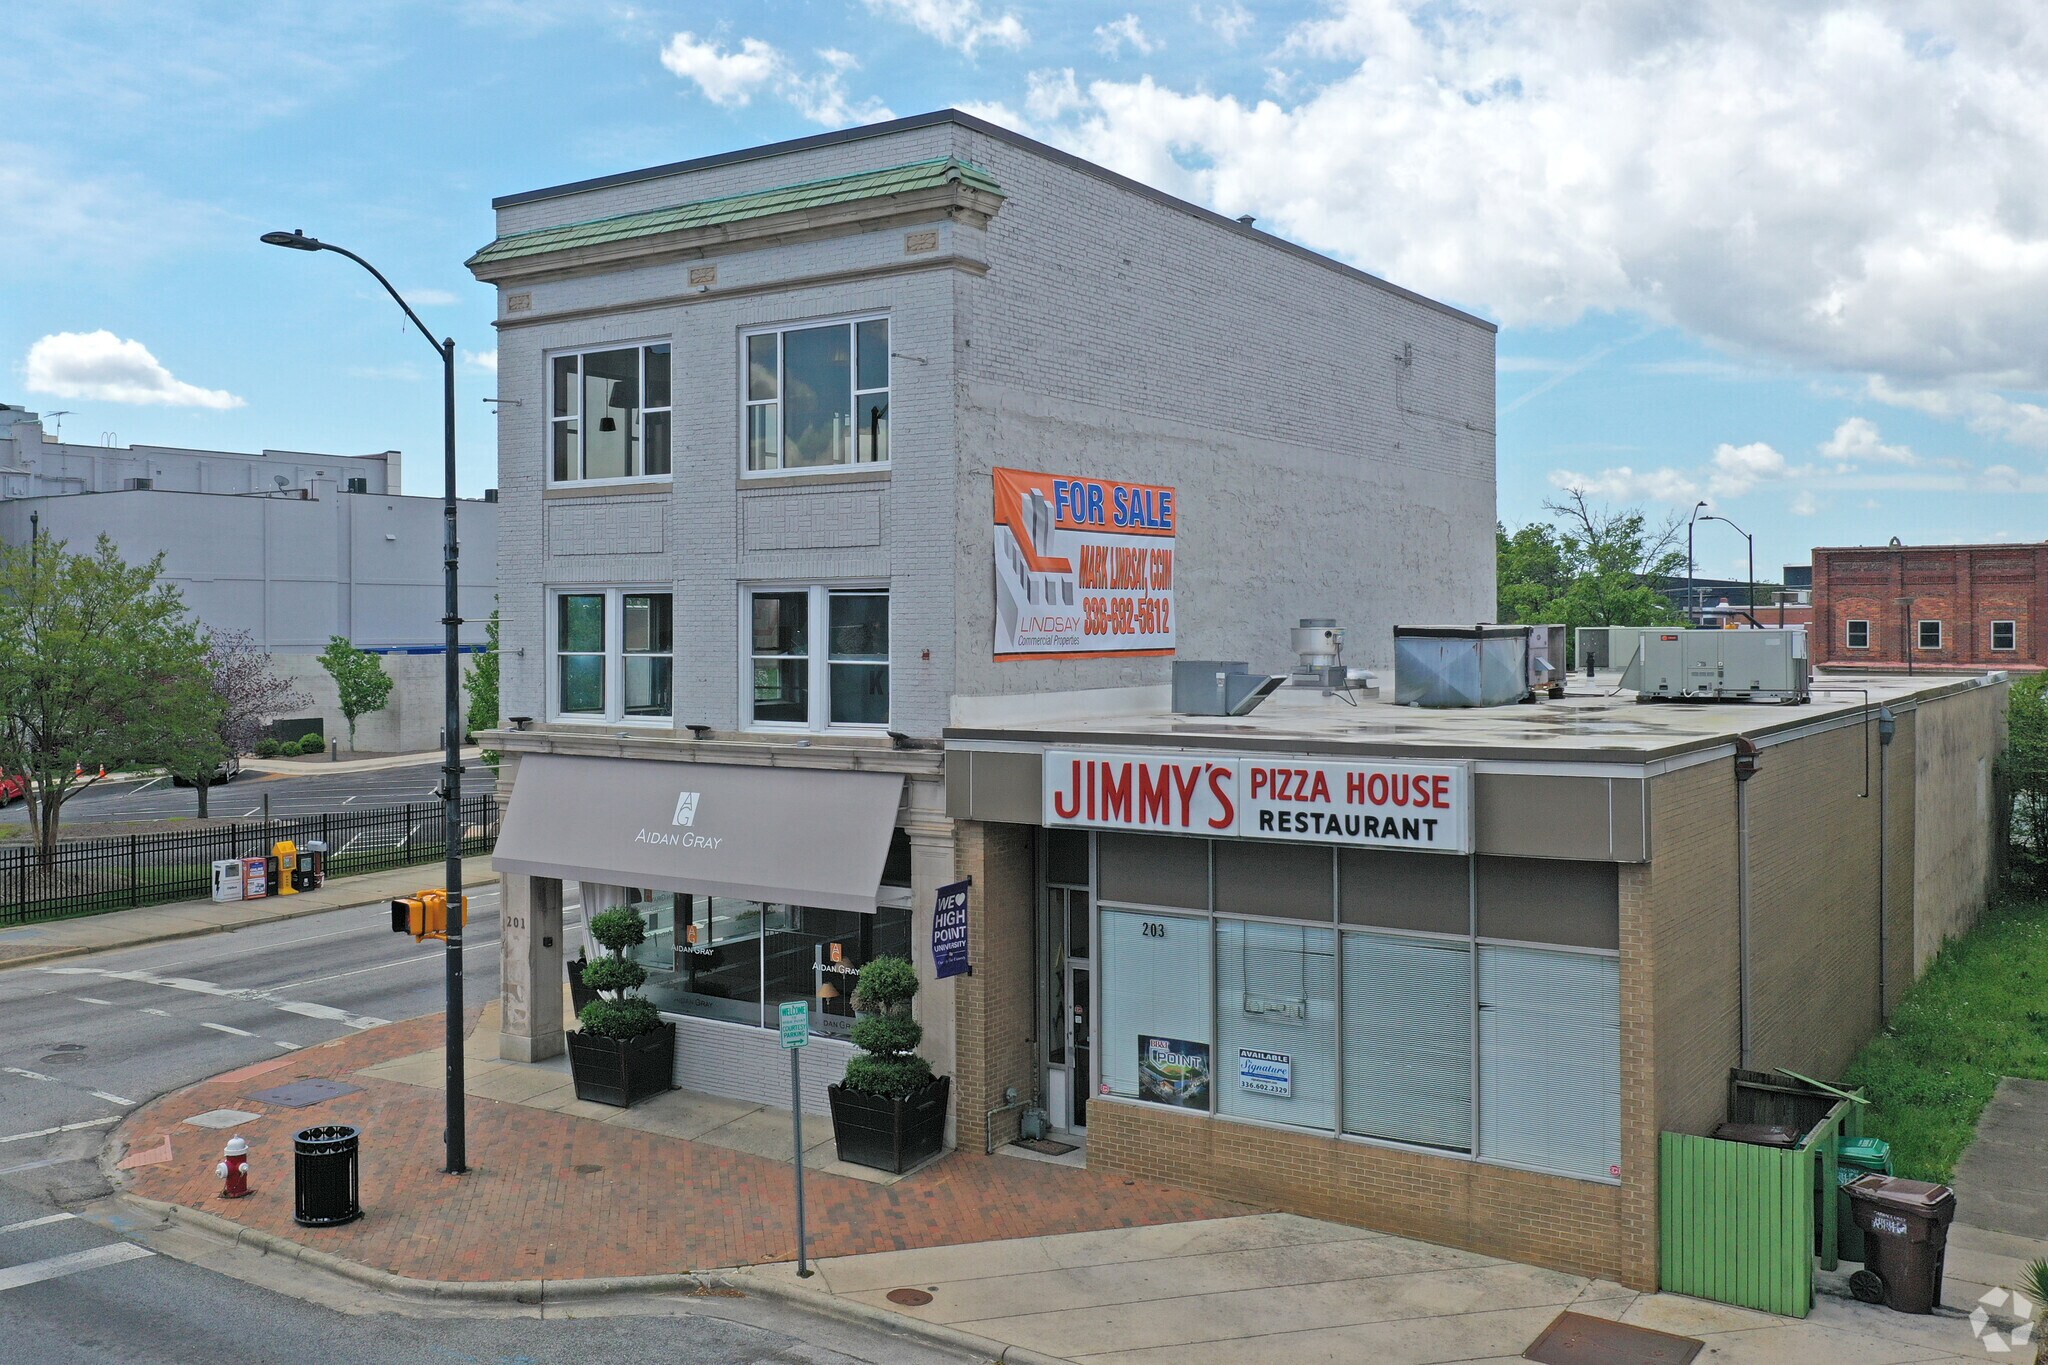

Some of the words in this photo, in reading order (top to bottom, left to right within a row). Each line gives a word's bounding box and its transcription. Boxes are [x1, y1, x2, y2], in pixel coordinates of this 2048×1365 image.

[1053, 479, 1104, 525] FOR
[1113, 485, 1172, 530] SALE
[1079, 545, 1109, 590] MARK
[1110, 547, 1148, 599] LINDSAY,
[1150, 548, 1172, 590] CCIM
[1020, 616, 1080, 632] LINDSAY
[1083, 596, 1170, 636] 336-692-5612
[1018, 635, 1052, 646] Commercial
[1054, 635, 1080, 647] Properties
[1054, 759, 1234, 830] JIMMY'S
[1250, 767, 1331, 804] PIZZA
[1346, 772, 1450, 809] HOUSE
[1258, 809, 1439, 842] RESTAURANT
[634, 828, 680, 846] AIDAN
[682, 832, 722, 850] GRAY
[938, 894, 955, 912] WE
[506, 916, 526, 929] 201
[935, 909, 965, 928] HIGH
[934, 926, 966, 943] POINT
[1142, 922, 1165, 938] 203
[671, 944, 694, 954] AIDAN
[694, 947, 714, 956] GRAY
[934, 940, 966, 952] UNIVERSITY
[812, 962, 838, 972] AIDAN
[838, 964, 860, 976] GRAY
[782, 1006, 806, 1016] WELCOME
[783, 1024, 806, 1032] COURTESY
[1157, 1052, 1201, 1068] POINT
[1241, 1050, 1288, 1062] AVAILABLE
[1241, 1059, 1287, 1075] Signature
[1242, 1081, 1288, 1093] 336.602.2329
